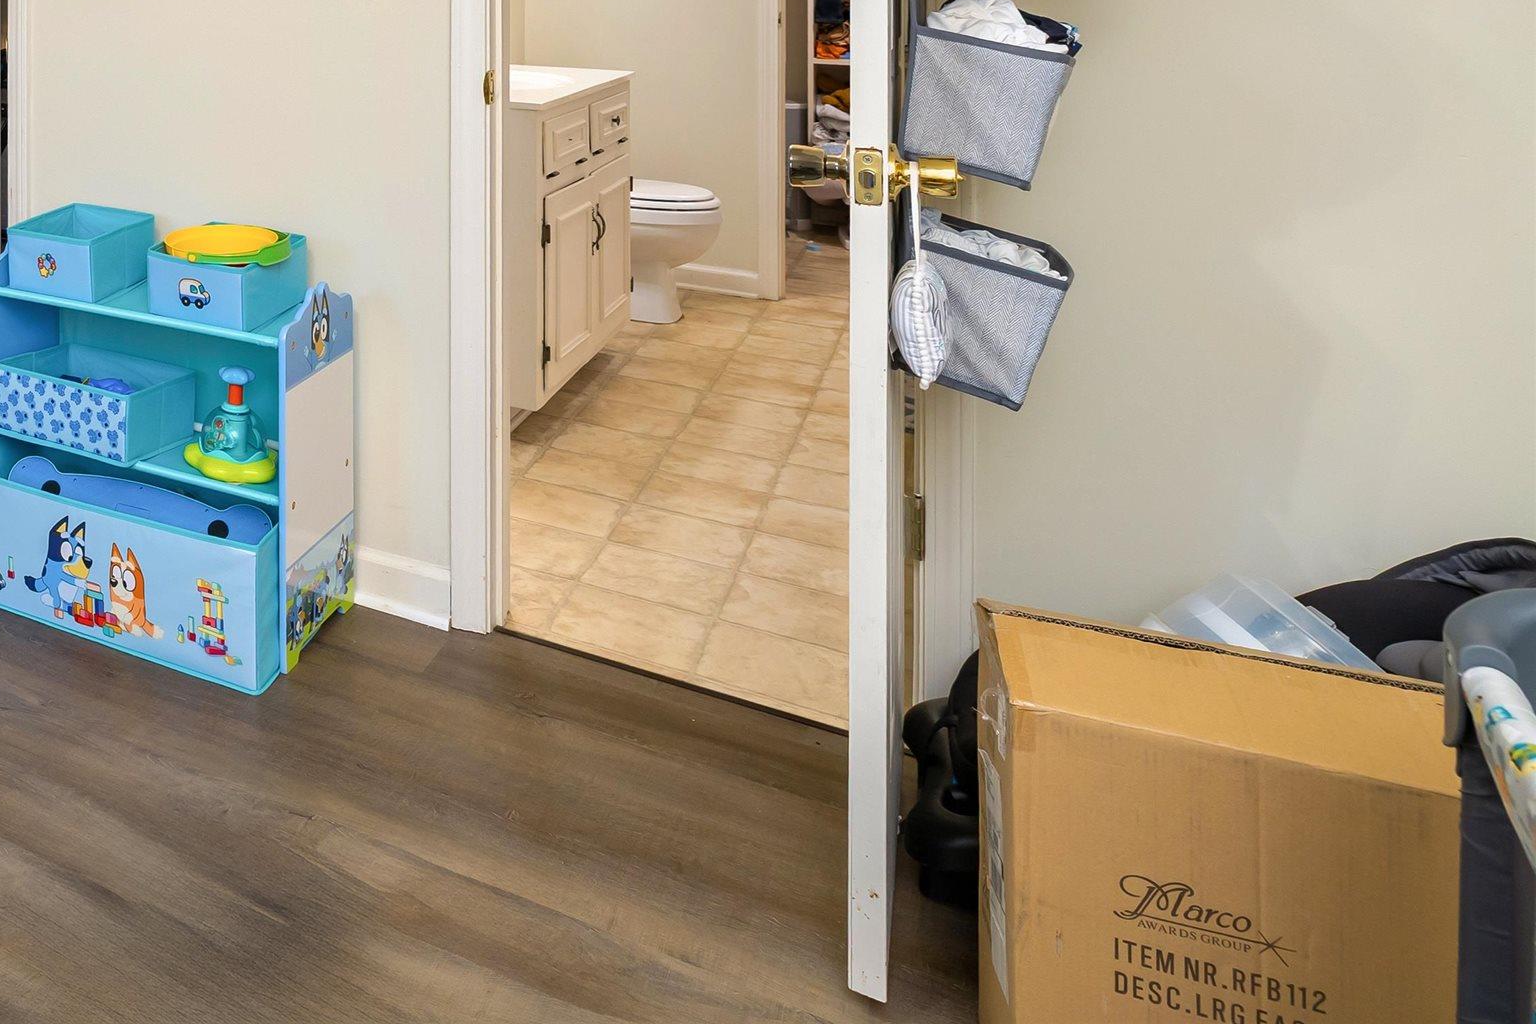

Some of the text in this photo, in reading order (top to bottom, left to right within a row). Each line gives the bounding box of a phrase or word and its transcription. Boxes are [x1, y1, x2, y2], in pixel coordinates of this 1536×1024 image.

[1113, 874, 1253, 933] Marco
[1136, 918, 1252, 953] AWARDS GROUP
[1113, 937, 1176, 976] ITEM
